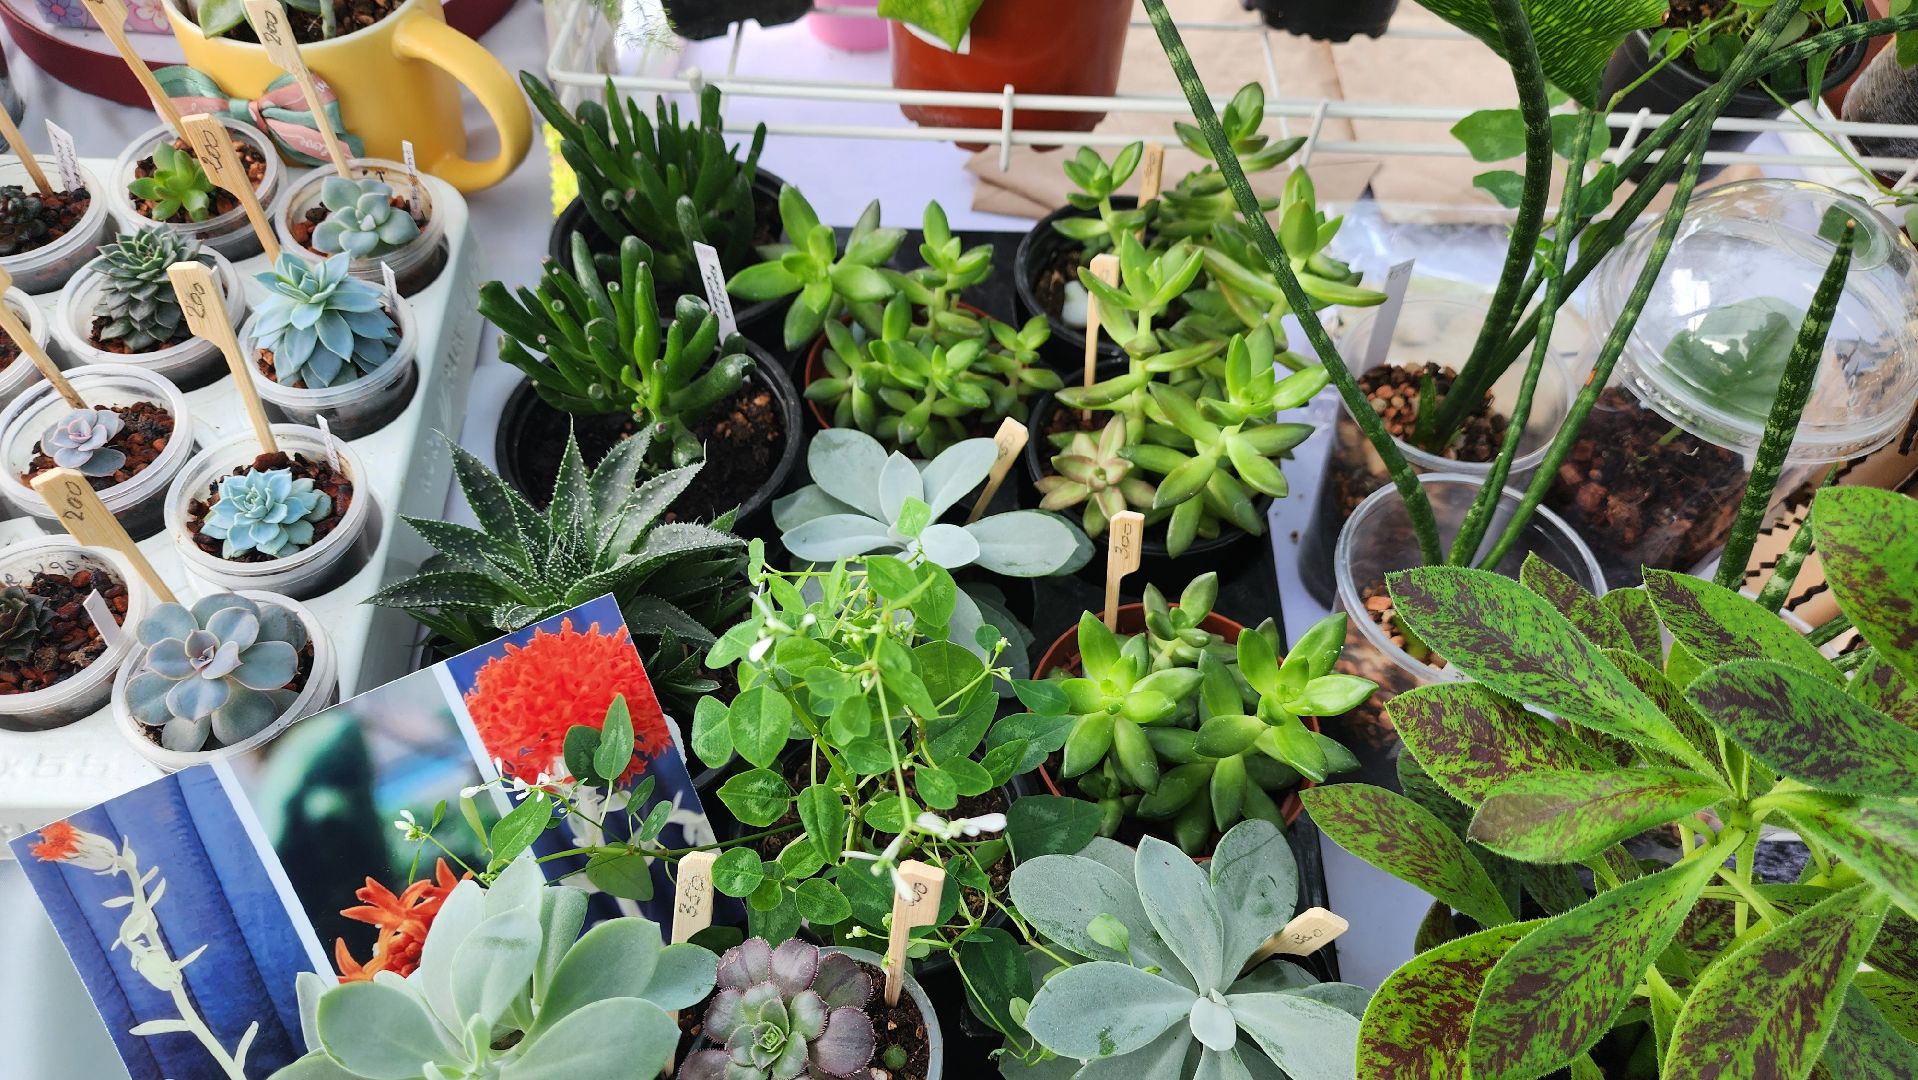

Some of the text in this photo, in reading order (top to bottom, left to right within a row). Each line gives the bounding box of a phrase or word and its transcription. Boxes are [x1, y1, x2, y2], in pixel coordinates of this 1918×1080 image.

[263, 10, 282, 46] 200
[201, 129, 223, 174] 200
[184, 282, 206, 319] 200
[62, 480, 85, 521] 200
[1114, 522, 1132, 560] 300
[678, 875, 705, 918] 350
